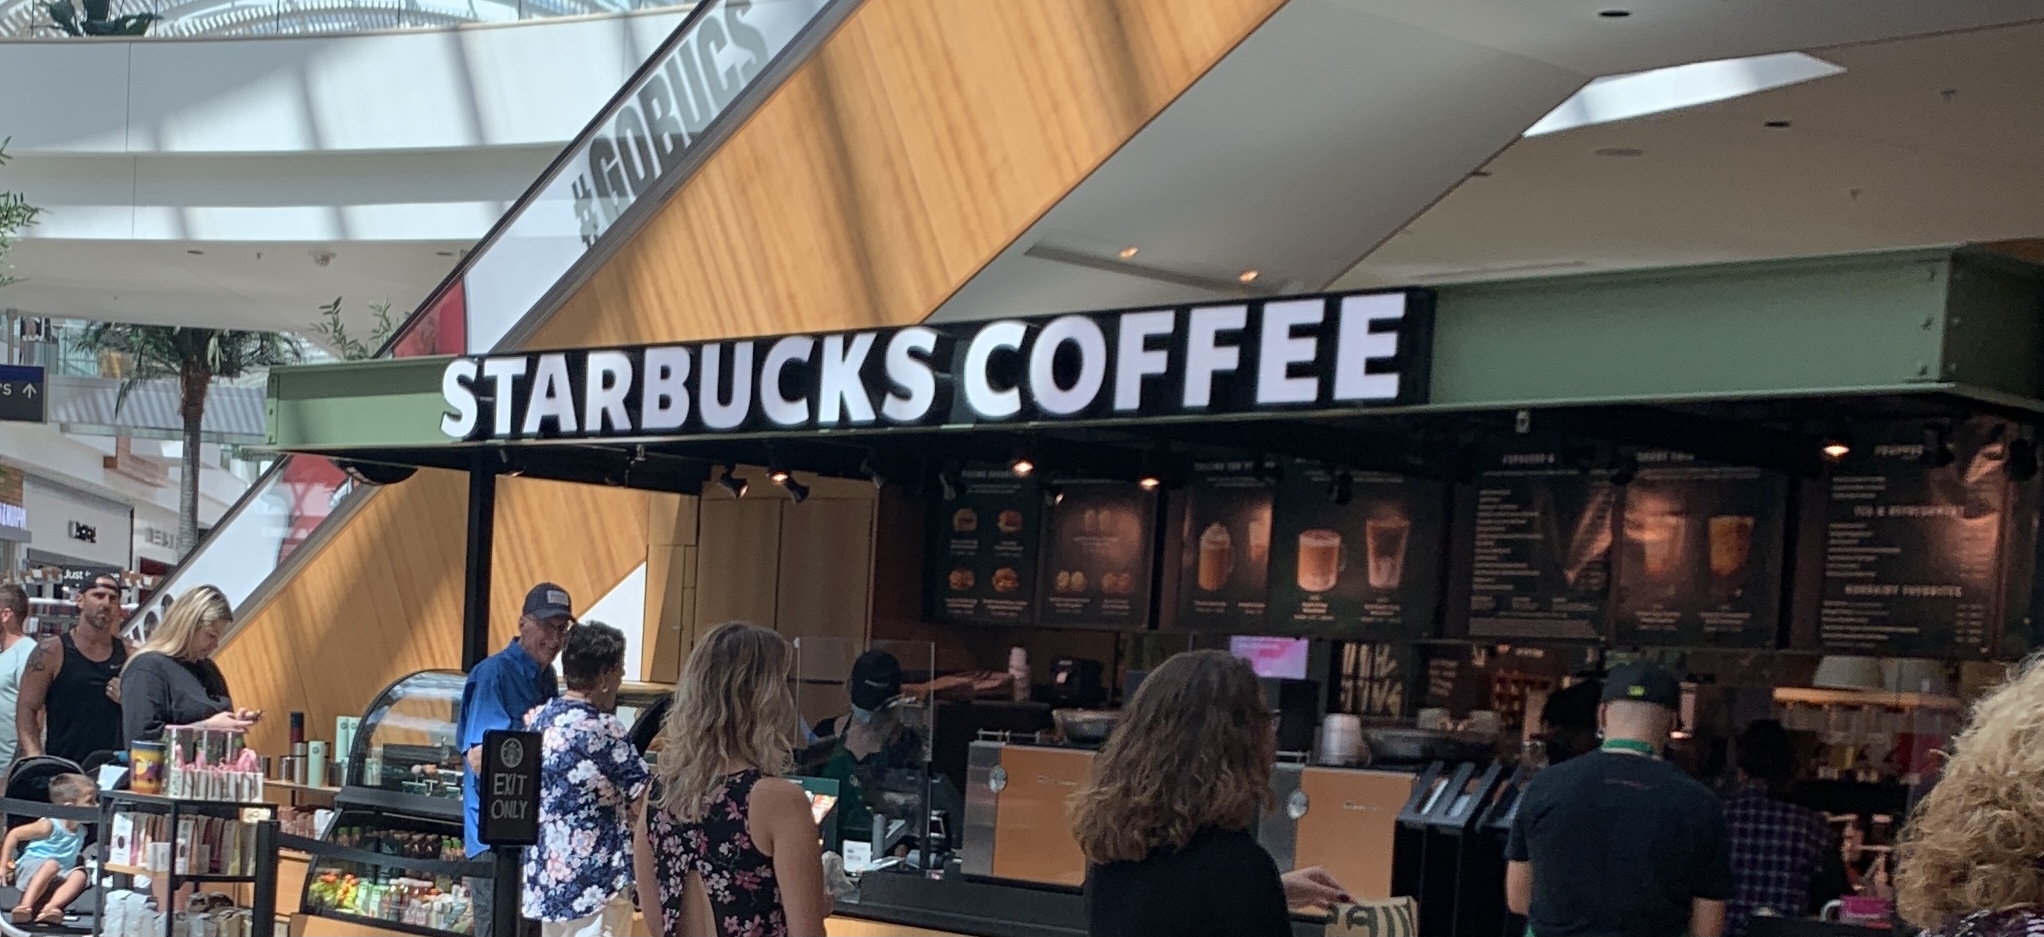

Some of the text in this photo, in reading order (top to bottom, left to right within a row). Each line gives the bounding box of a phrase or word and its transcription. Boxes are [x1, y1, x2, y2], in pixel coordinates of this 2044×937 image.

[441, 293, 1406, 440] STARBUCKS COFFEE
[63, 568, 84, 580] Just
[493, 772, 528, 796] EXIT
[491, 799, 528, 820] ONLY
